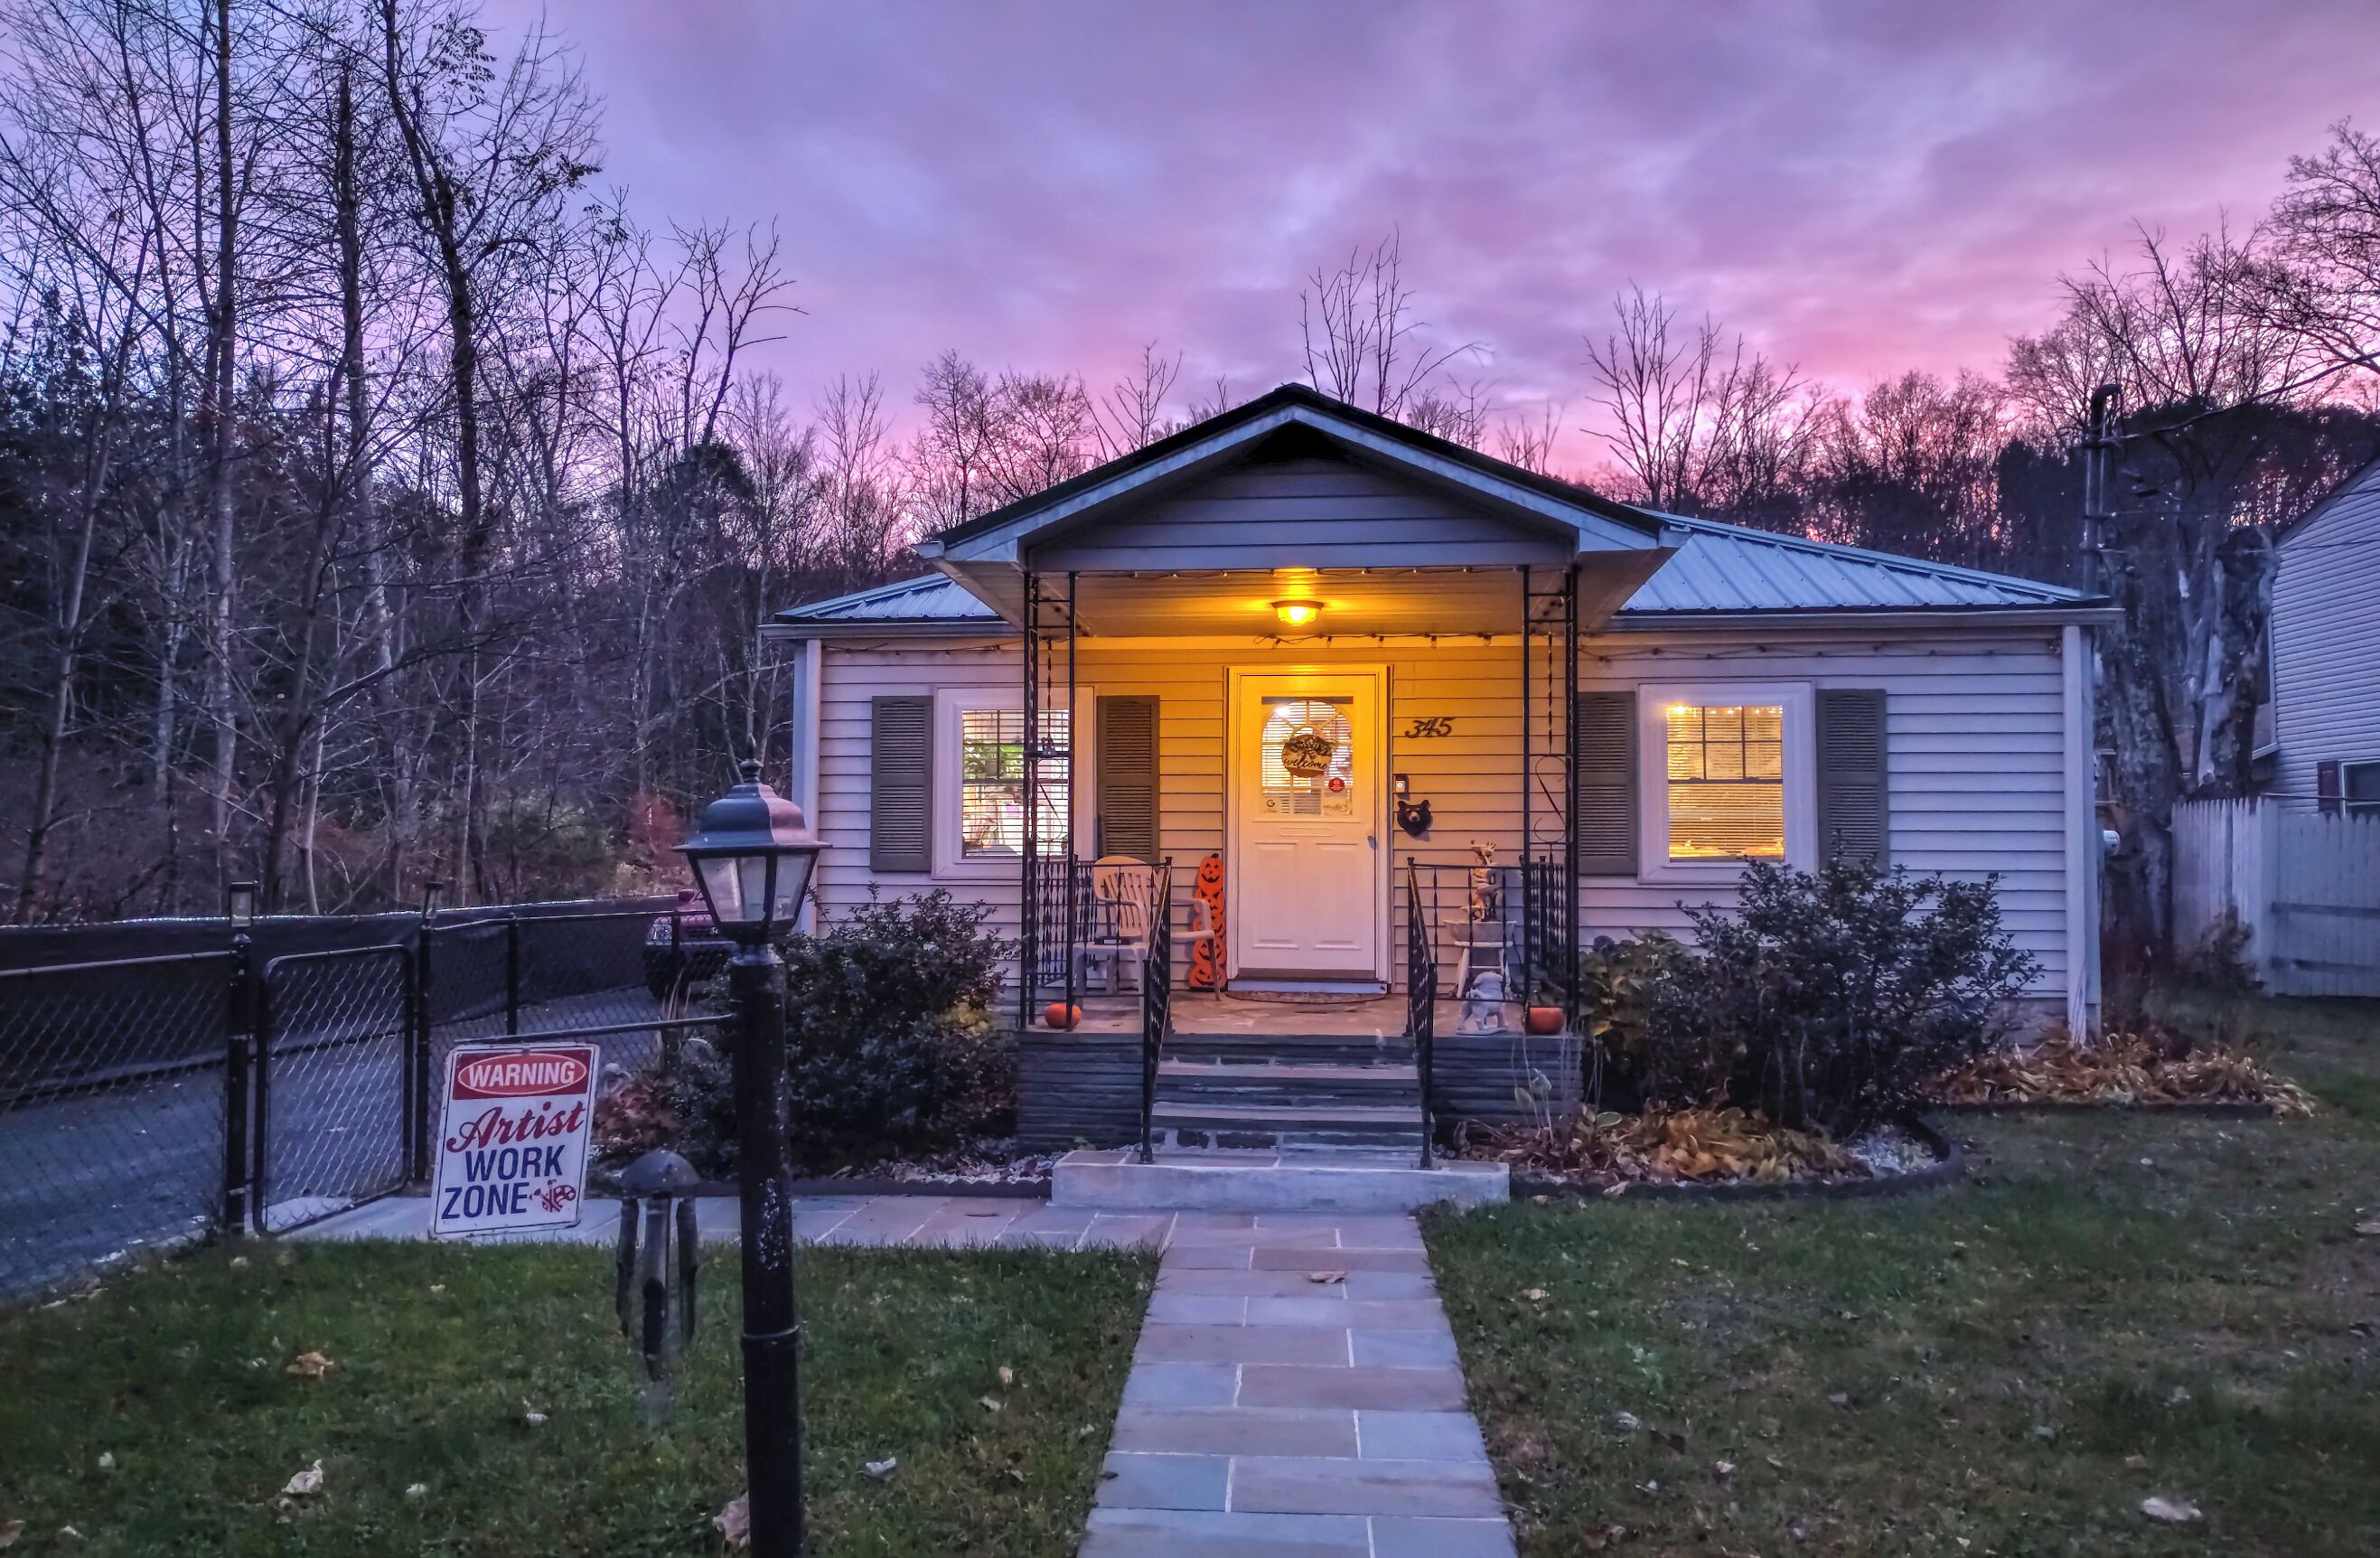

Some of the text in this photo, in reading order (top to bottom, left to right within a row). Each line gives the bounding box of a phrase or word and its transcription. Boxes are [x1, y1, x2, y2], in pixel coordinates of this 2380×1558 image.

[1405, 717, 1455, 738] 345
[1283, 756, 1328, 771] welcome
[467, 1061, 576, 1088] WARNING
[445, 1100, 586, 1153] Artist
[464, 1144, 567, 1183] WORK
[441, 1181, 530, 1220] ZONE
